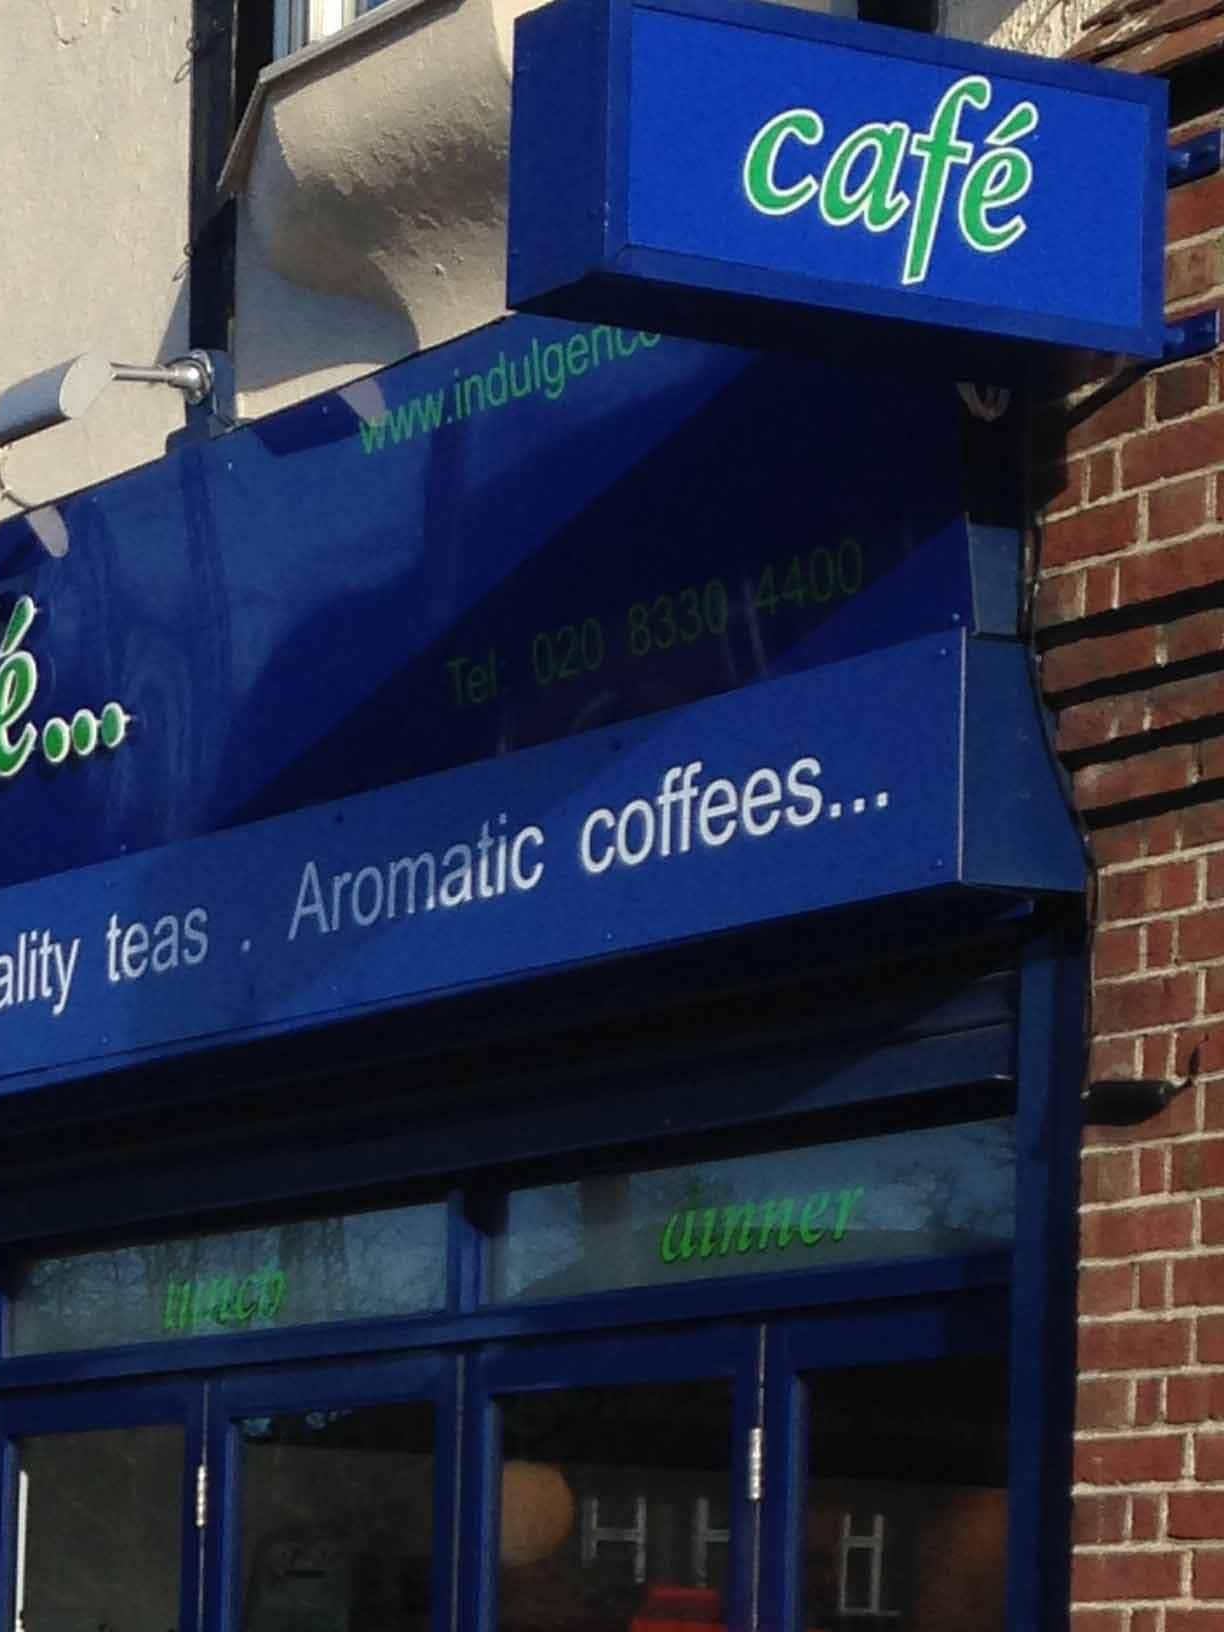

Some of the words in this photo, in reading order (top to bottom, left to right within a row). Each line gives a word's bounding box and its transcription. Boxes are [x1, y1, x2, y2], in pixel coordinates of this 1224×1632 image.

[743, 74, 1039, 284] café
[531, 617, 606, 687] 020
[627, 577, 729, 657] 8330
[756, 538, 864, 615] 4400
[106, 907, 209, 982] teas
[287, 813, 544, 940] Aromatic
